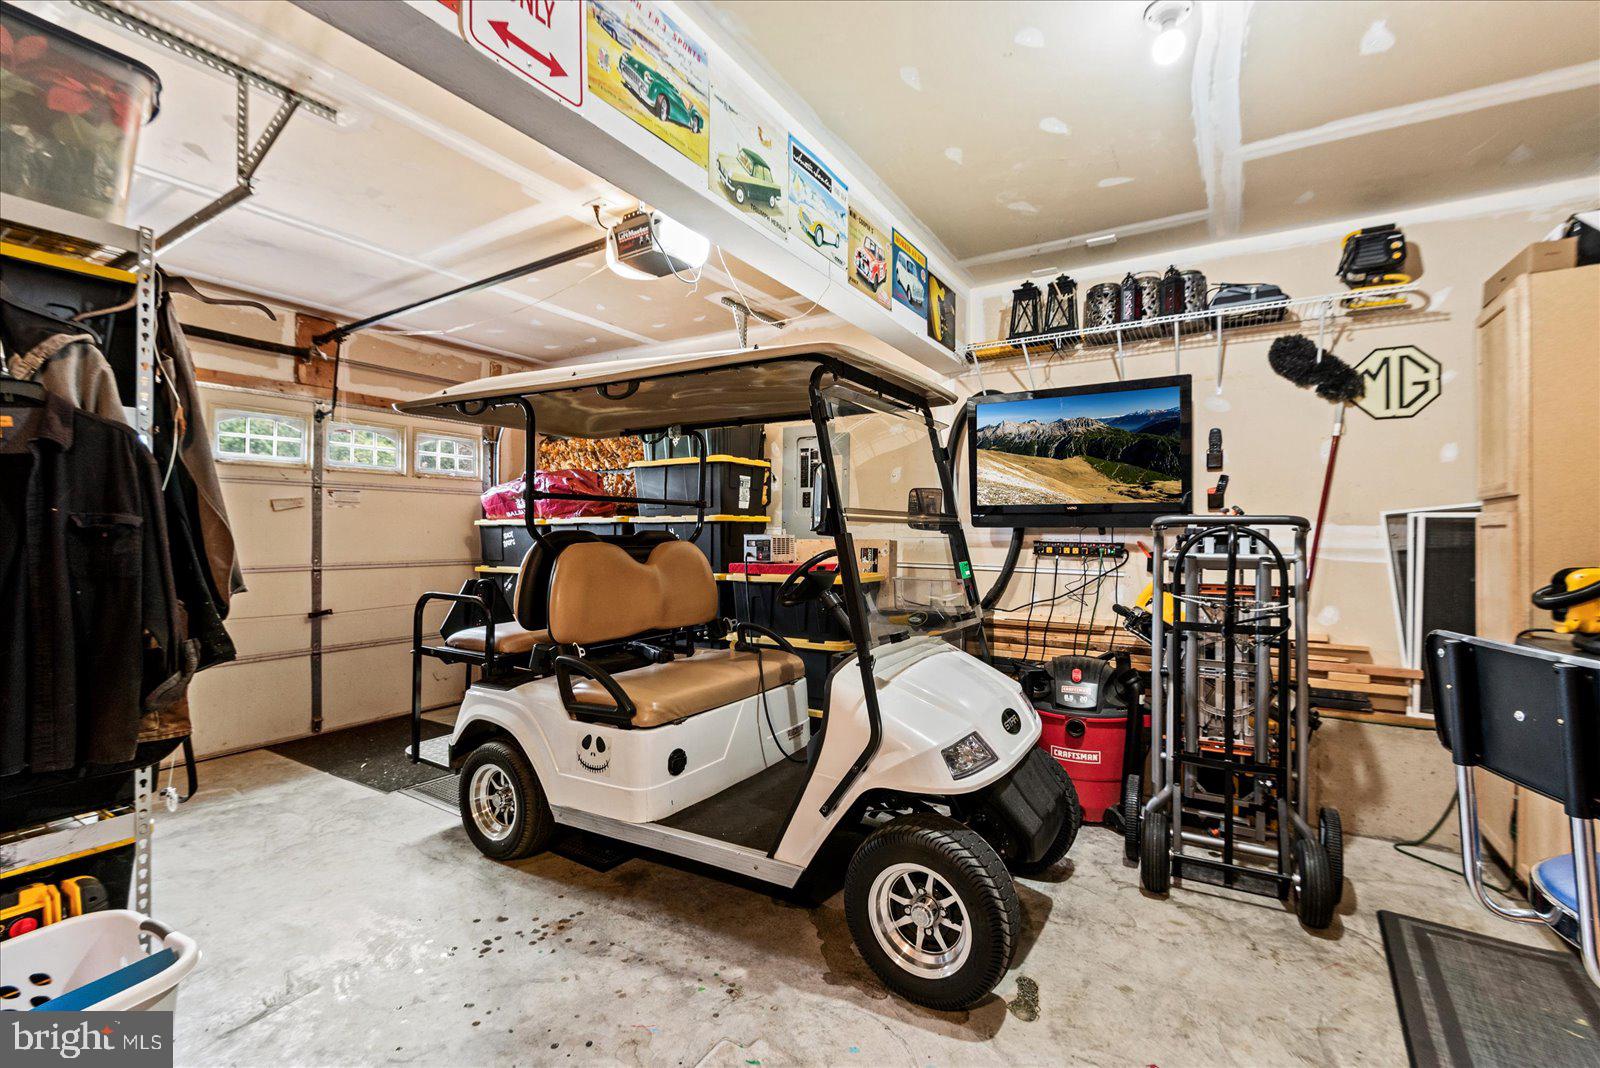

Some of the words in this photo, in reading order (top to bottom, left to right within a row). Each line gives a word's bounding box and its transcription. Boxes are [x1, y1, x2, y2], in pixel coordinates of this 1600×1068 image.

[750, 202, 771, 222] TRIUMPH
[771, 216, 787, 234] HERALD
[1359, 355, 1429, 409] MG
[1053, 748, 1099, 761] CRAFTSMAN
